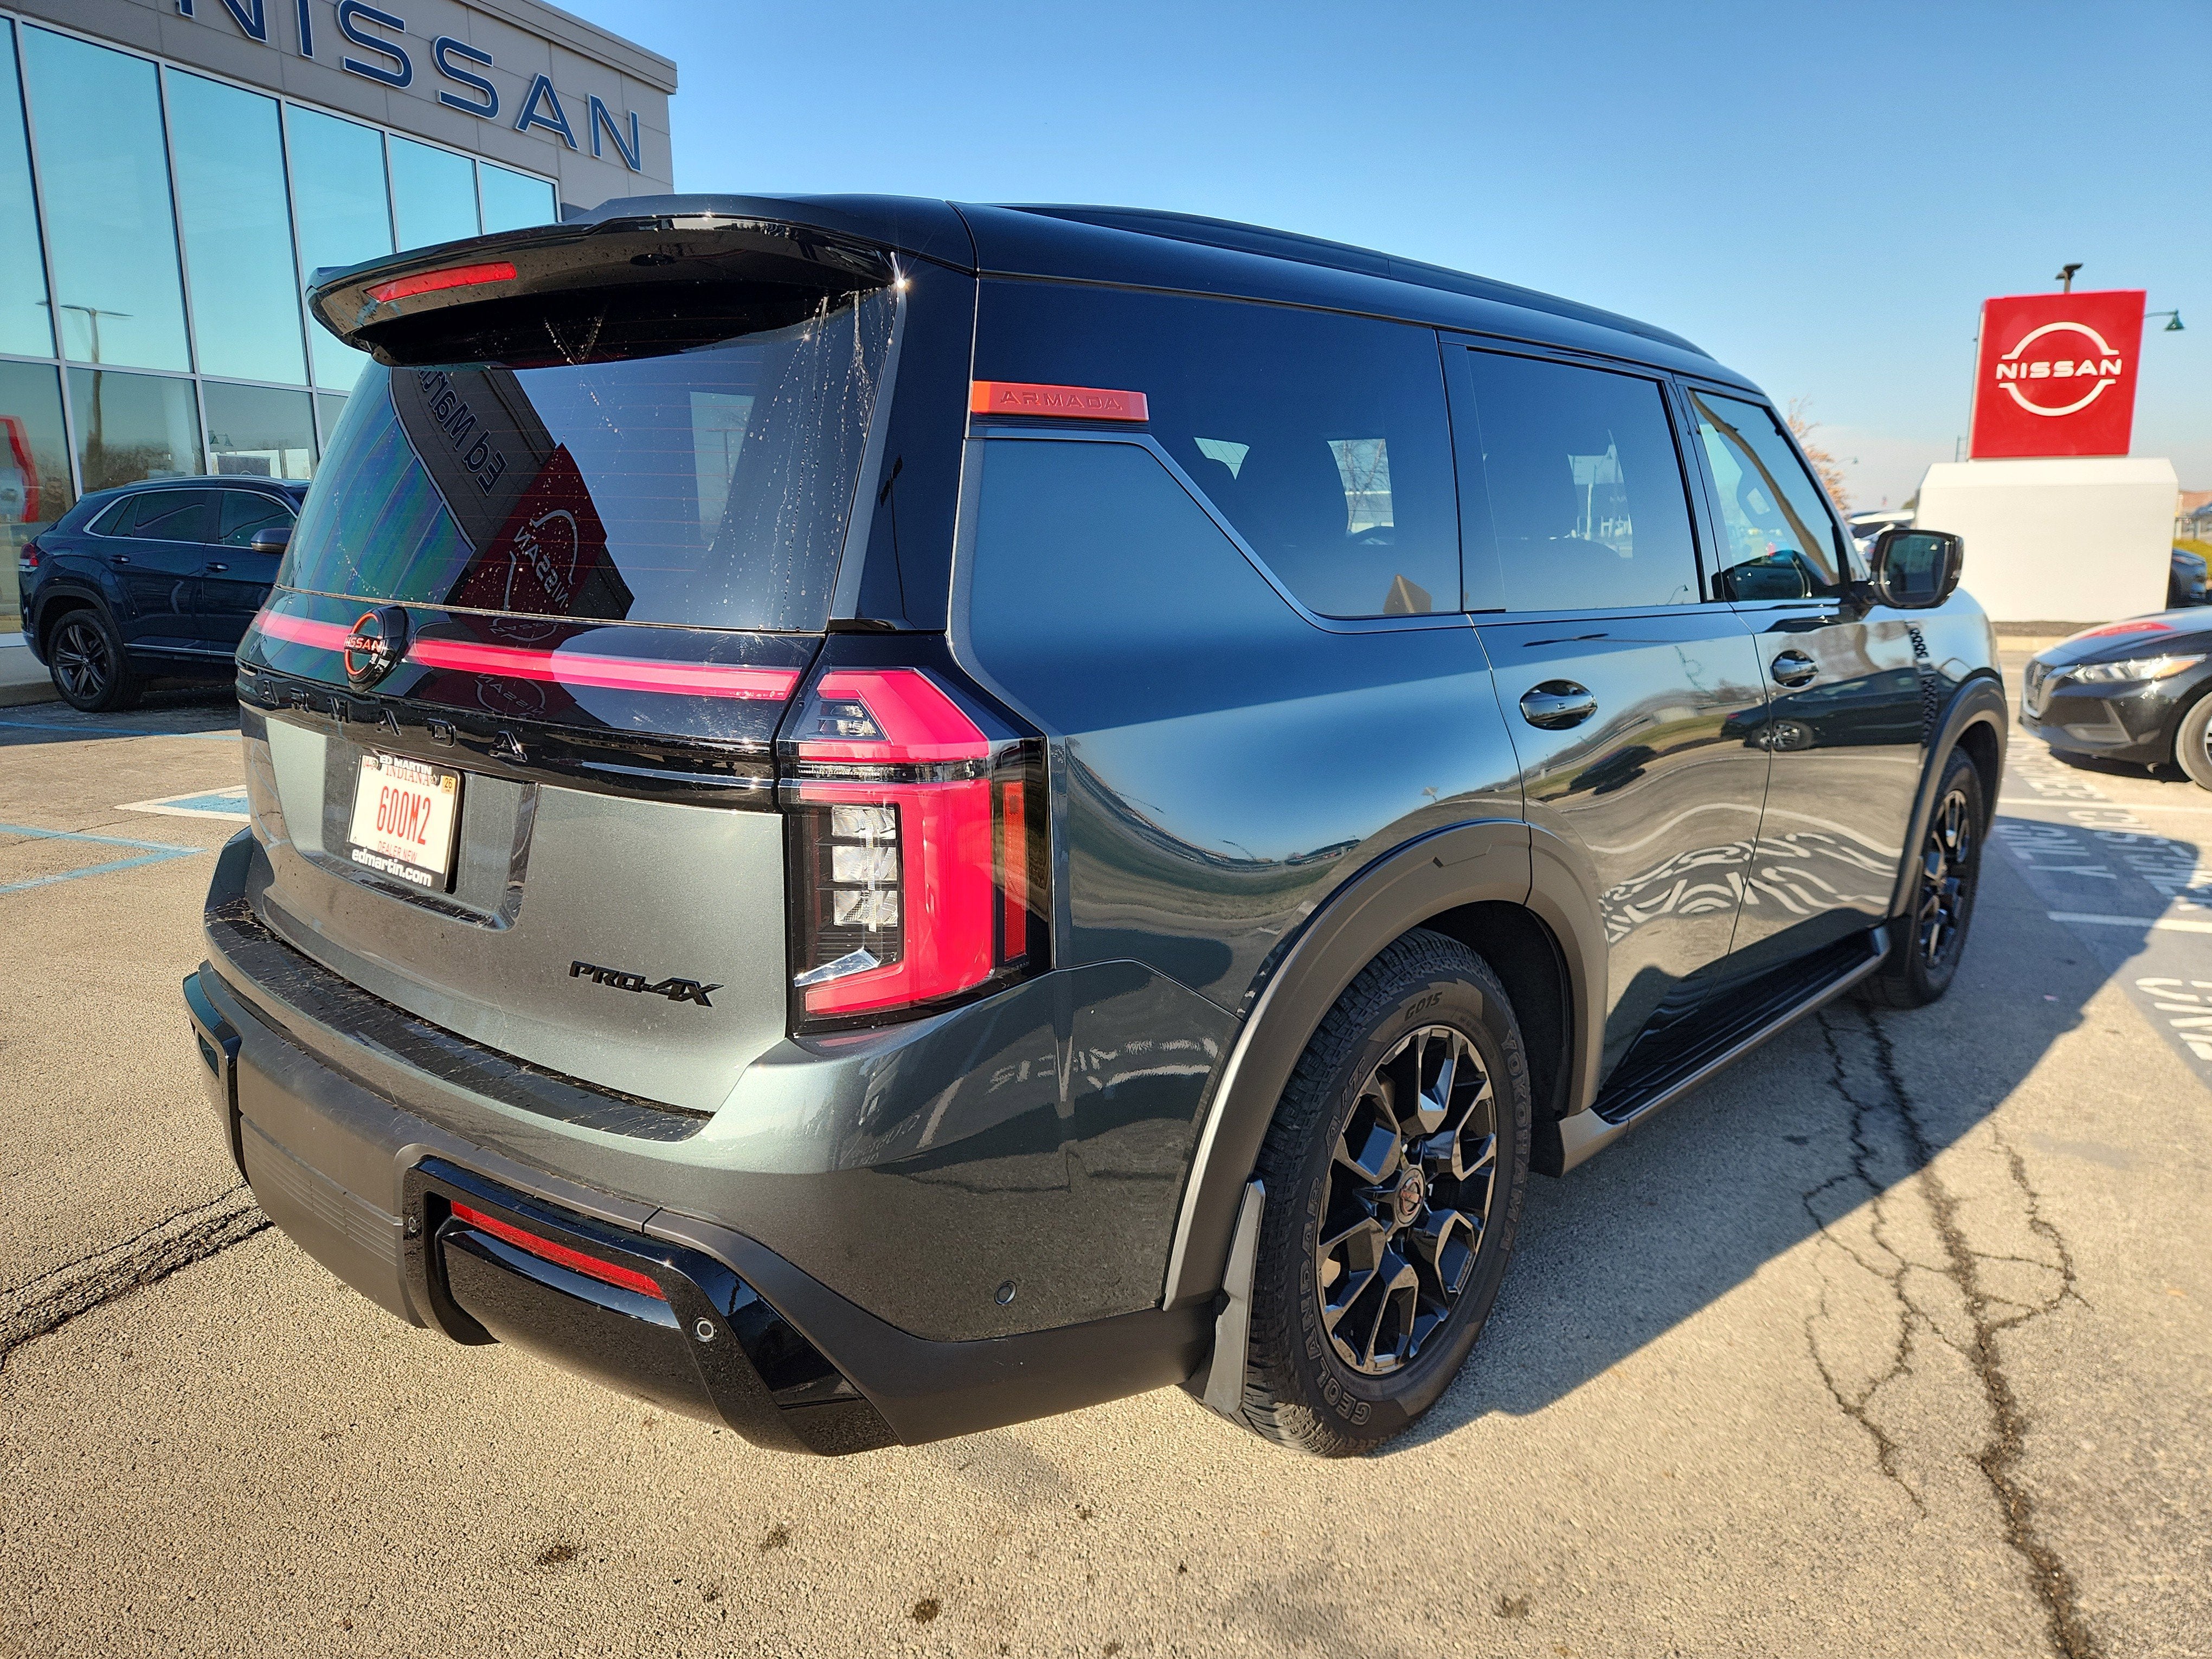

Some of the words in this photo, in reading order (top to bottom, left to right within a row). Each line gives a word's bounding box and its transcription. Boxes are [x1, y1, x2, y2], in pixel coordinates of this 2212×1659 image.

[1996, 358, 2123, 380] NISSAN
[1000, 391, 1123, 410] ARMADA
[260, 679, 528, 762] ARMADA
[380, 755, 393, 766] ED
[394, 757, 433, 775] MARTIN
[385, 764, 430, 787] INDIANA
[444, 777, 452, 789] 26
[376, 786, 431, 845] 600M2
[377, 841, 401, 859] DEALER
[403, 848, 418, 864] NEW
[351, 848, 432, 887] edmartin.com
[569, 960, 724, 1008] PRO-4X
